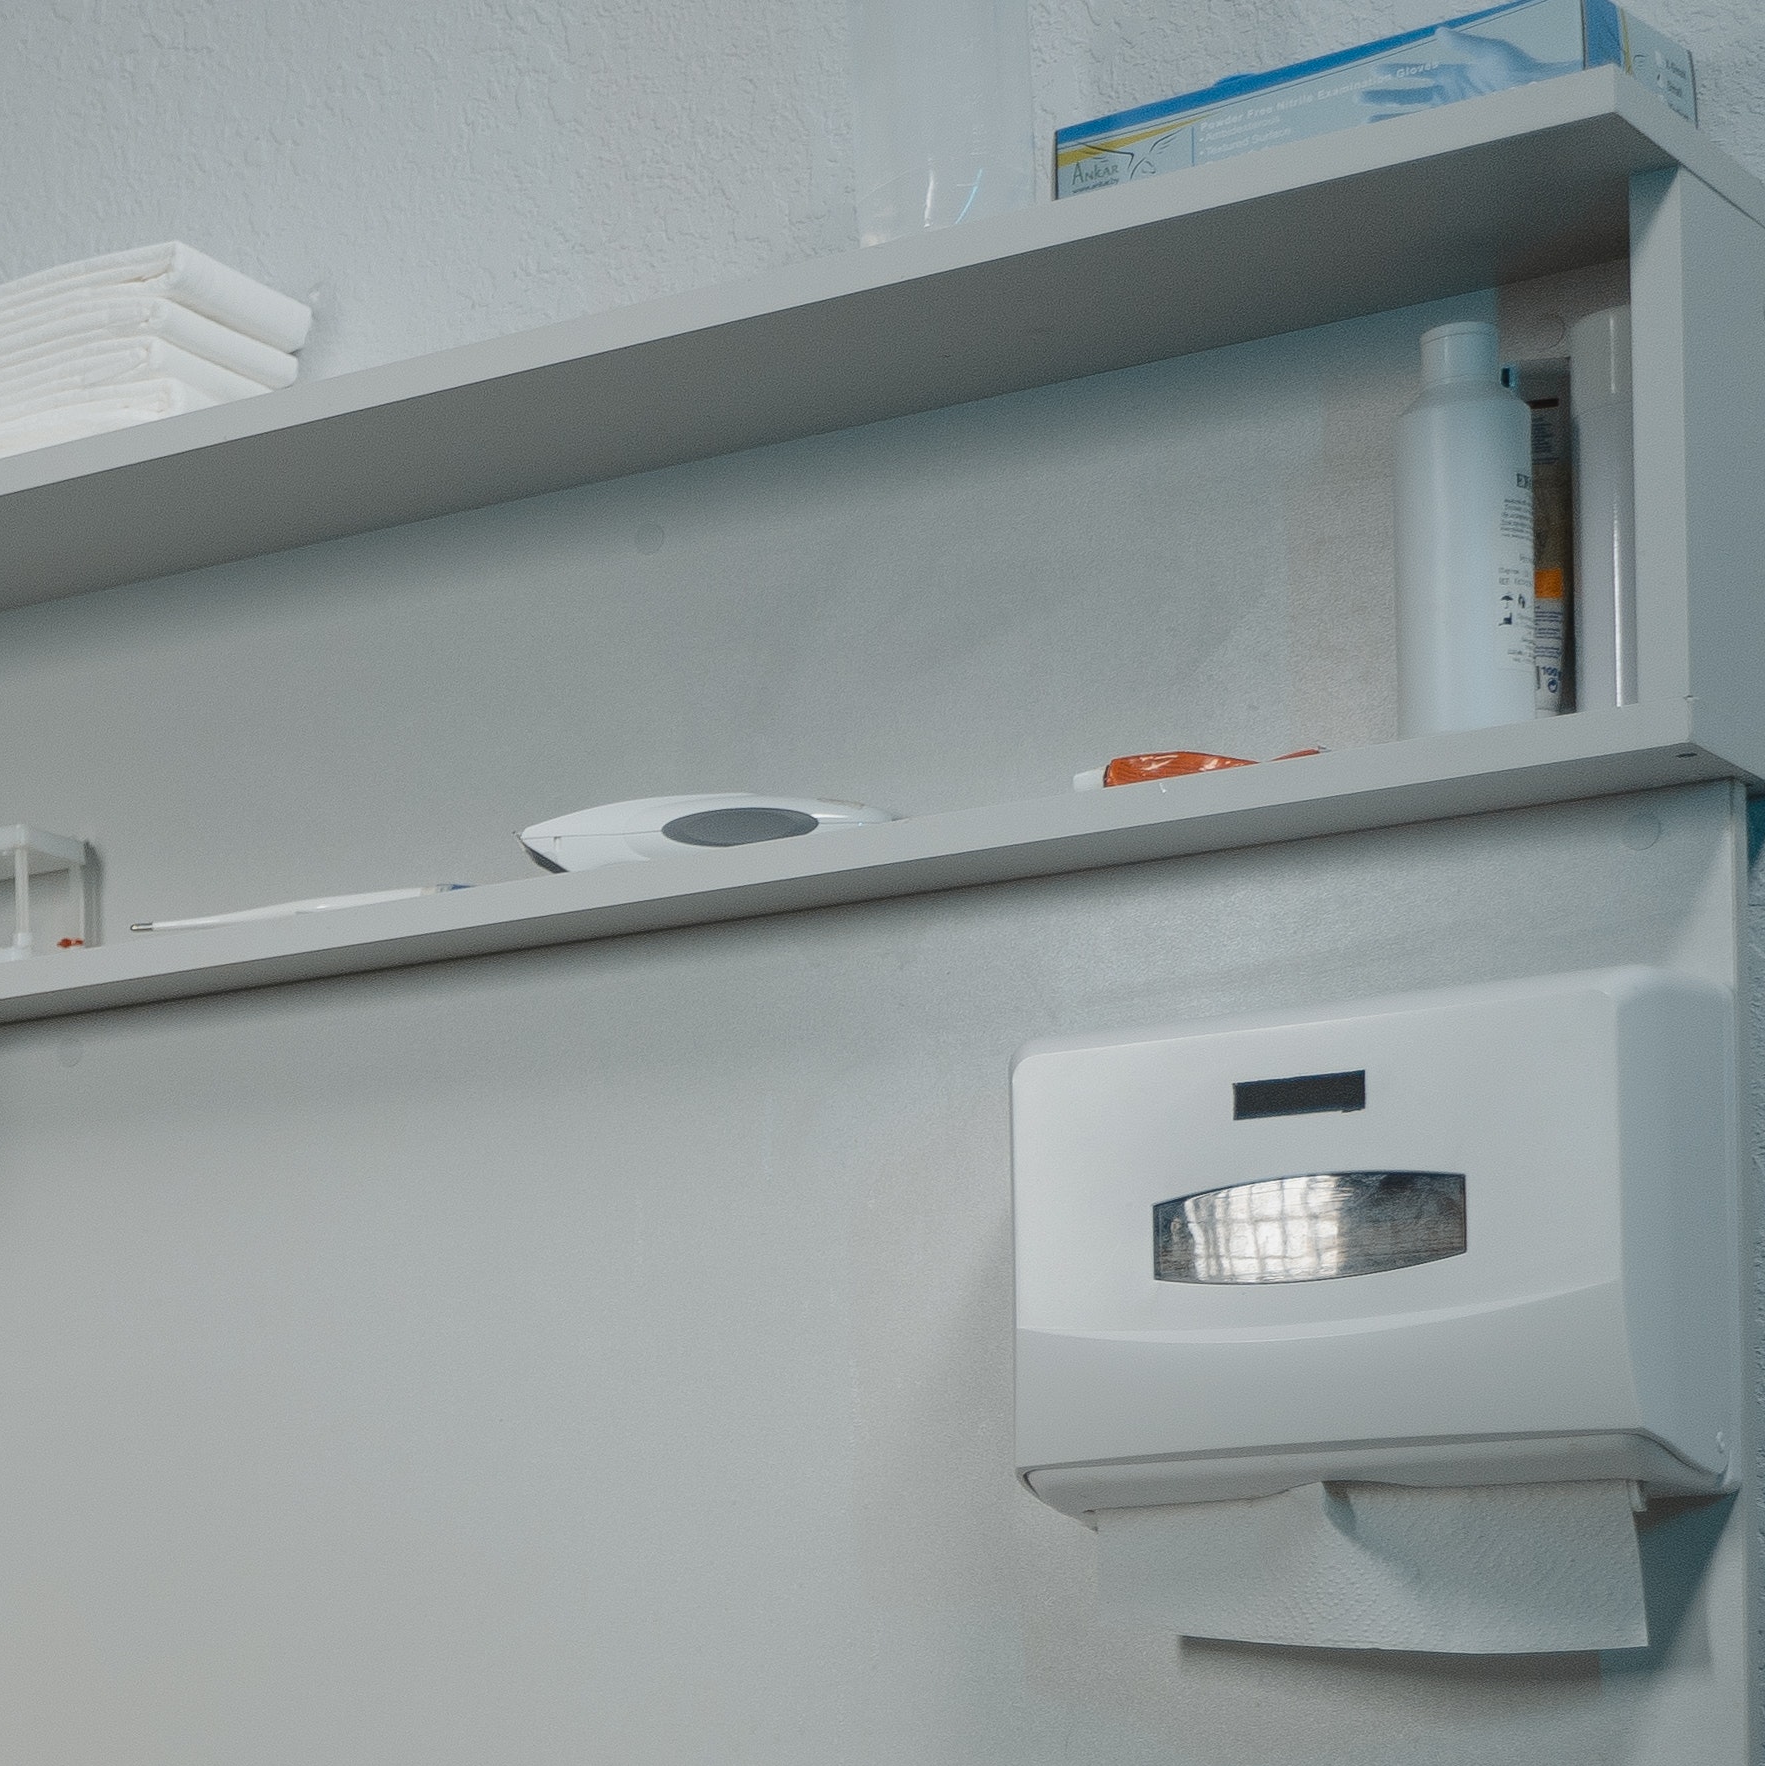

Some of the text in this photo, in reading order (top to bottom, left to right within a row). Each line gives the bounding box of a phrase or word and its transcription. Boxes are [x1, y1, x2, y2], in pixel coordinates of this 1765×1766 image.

[1246, 104, 1273, 119] Free
[1276, 94, 1314, 112] Nitrile
[1396, 61, 1440, 79] Gloves
